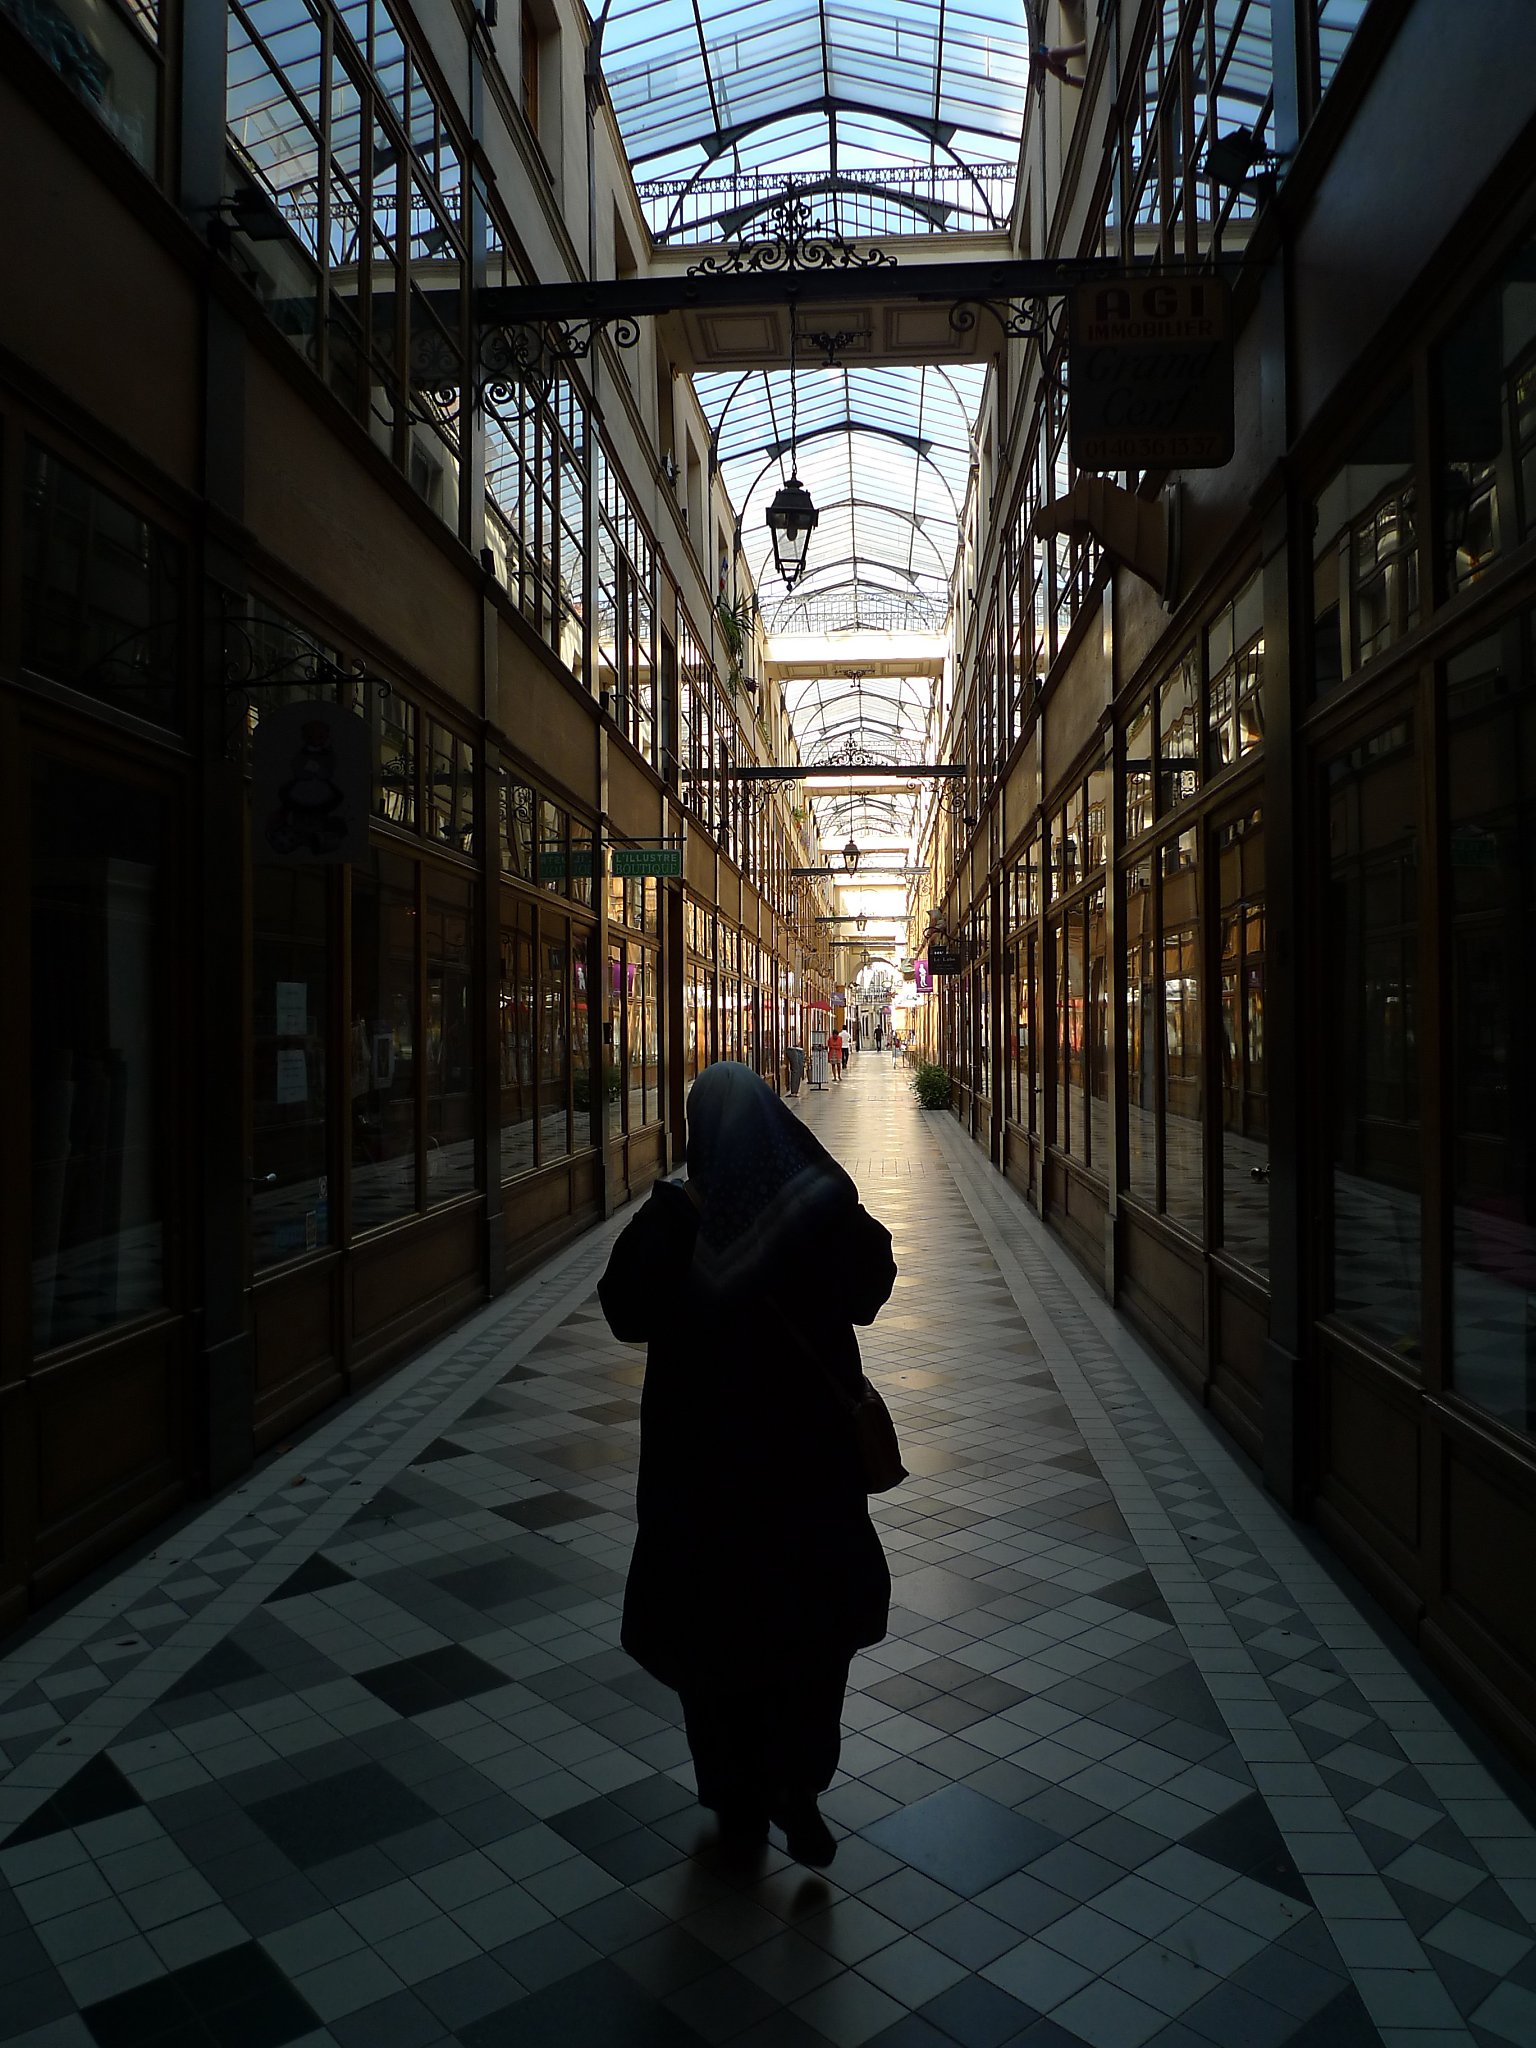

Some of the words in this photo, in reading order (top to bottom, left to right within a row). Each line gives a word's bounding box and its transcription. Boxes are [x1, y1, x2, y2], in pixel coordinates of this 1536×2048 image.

[1095, 285, 1204, 321] AGI
[1087, 319, 1213, 341] IMMOBILIER
[1085, 341, 1221, 382] Grand
[1102, 386, 1198, 428] Cerf
[1085, 440, 1107, 458] 01
[1110, 439, 1136, 457] 40
[616, 854, 678, 863] L'ILLUSTRE
[616, 863, 678, 874] BOUTIQUE
